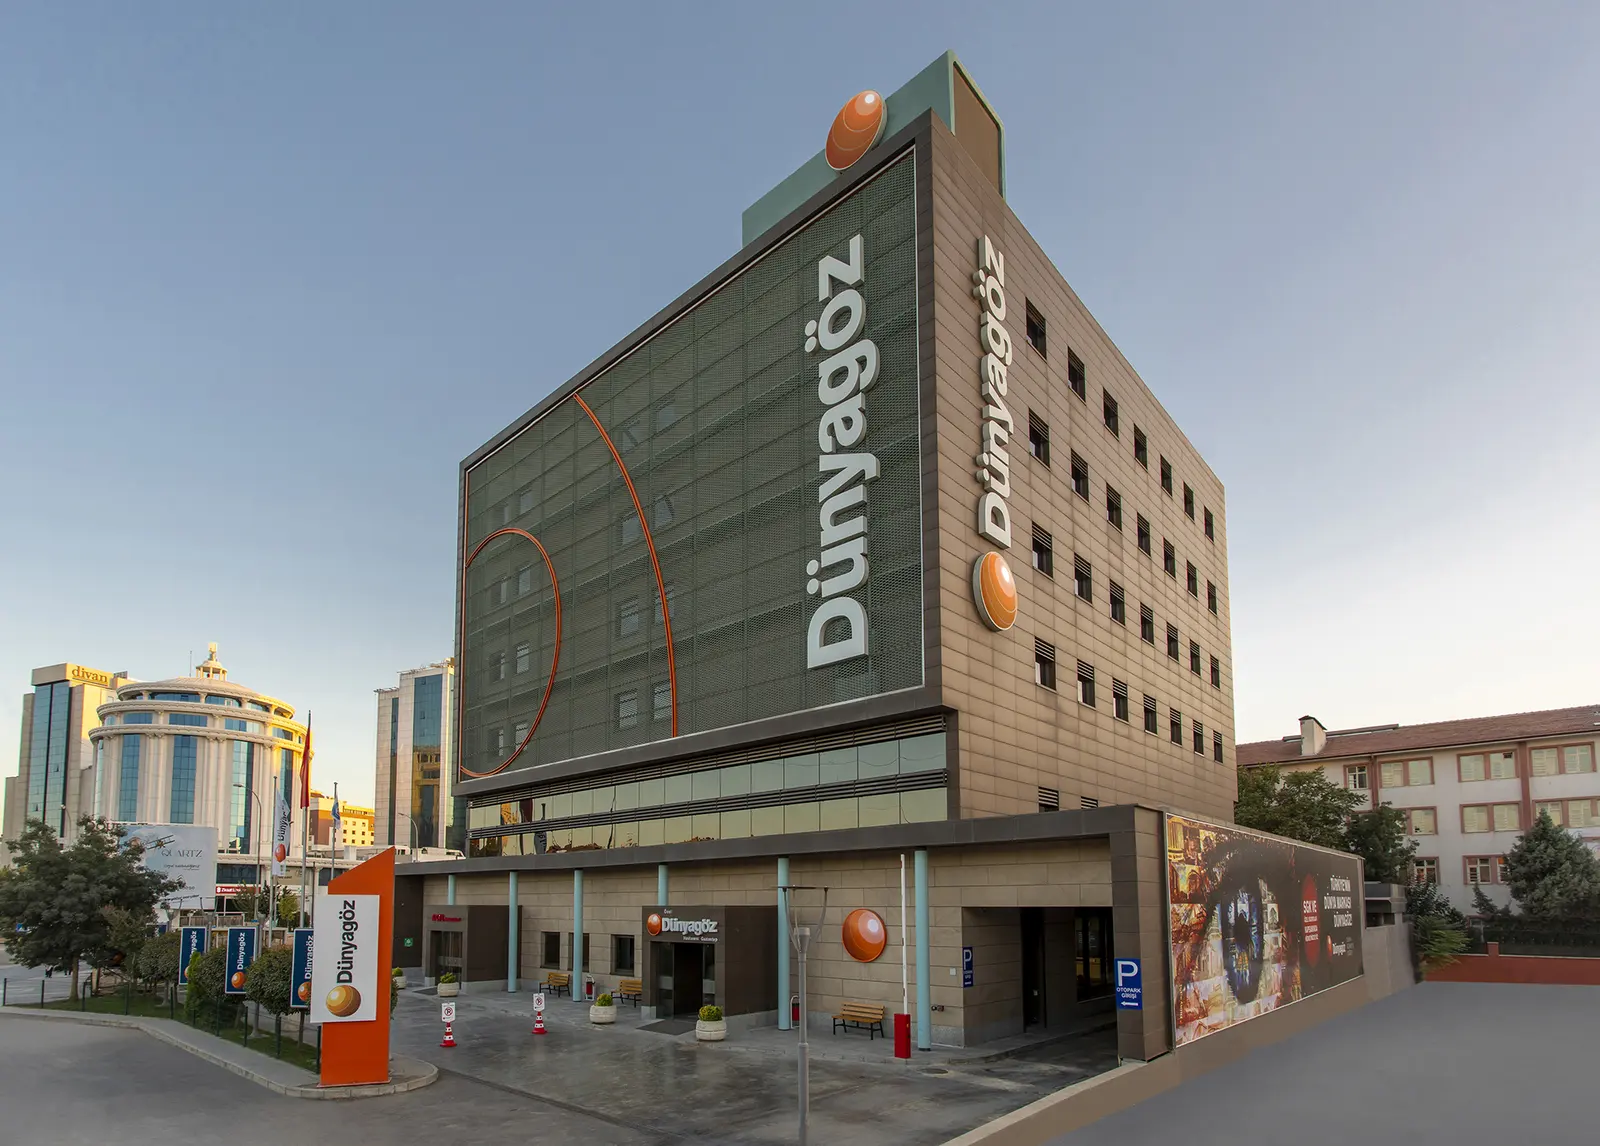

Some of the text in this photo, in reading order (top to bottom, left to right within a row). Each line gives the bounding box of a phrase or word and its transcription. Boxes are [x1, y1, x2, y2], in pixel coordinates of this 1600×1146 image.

[973, 234, 1014, 549] Dünyagöz
[805, 234, 880, 669] Dünyagöz
[71, 665, 108, 683] divan
[161, 849, 203, 858] QUARTZ
[336, 900, 358, 984] Dünyagöz
[662, 917, 718, 935] Dünyagöz
[237, 932, 246, 970] Dünyagöz
[304, 935, 313, 980] Dünyagöz
[1117, 961, 1138, 986] P
